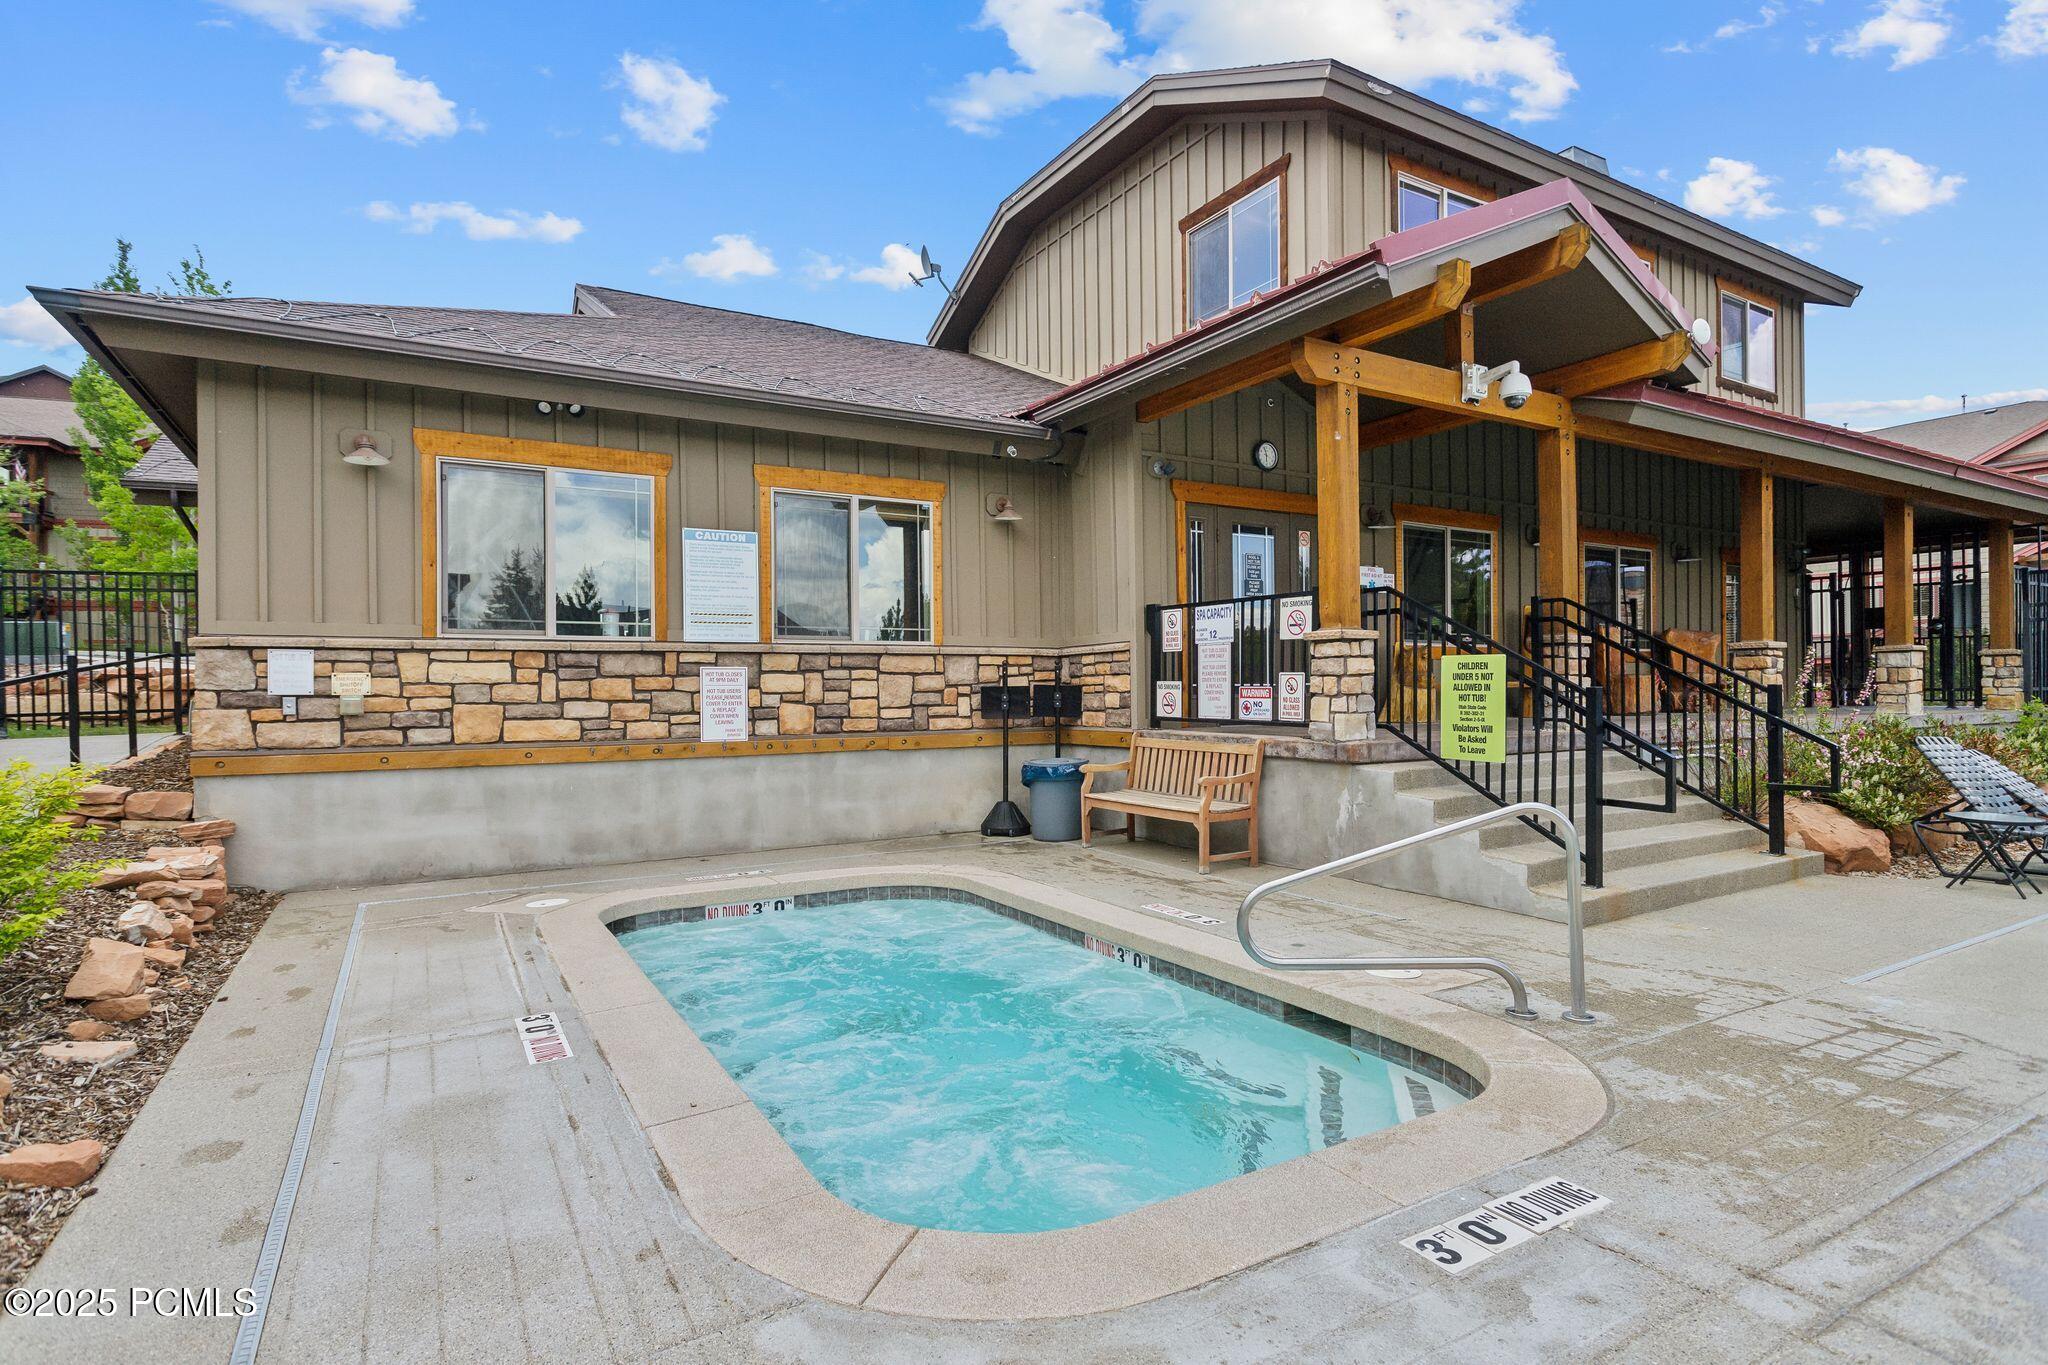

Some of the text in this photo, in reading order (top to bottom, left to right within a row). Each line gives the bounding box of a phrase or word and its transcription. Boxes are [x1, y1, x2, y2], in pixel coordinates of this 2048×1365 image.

[695, 531, 746, 542] CAUTION
[1289, 600, 1313, 608] SMOKING
[1196, 606, 1232, 621] SPA CAPACITY
[1209, 629, 1218, 639] 12
[1457, 662, 1489, 670] CHILDREN
[1452, 672, 1494, 681] UNDER 5 NOT
[1453, 683, 1491, 692] ALLOWED IN
[1241, 689, 1270, 698] WARNING
[1458, 693, 1487, 703] HOT TUB!
[1452, 723, 1493, 733] Violators Will
[1458, 734, 1487, 744] Be Asked
[1459, 745, 1486, 755] To Leave
[707, 907, 719, 920] NO
[722, 903, 750, 918] DIVING
[752, 902, 763, 915] 3
[1117, 947, 1125, 963] 3
[1133, 952, 1142, 969] 0
[521, 1014, 551, 1022] 3
[525, 1024, 555, 1033] 0
[1415, 1181, 1600, 1265] 3 FT 0 IN NO DIVING
